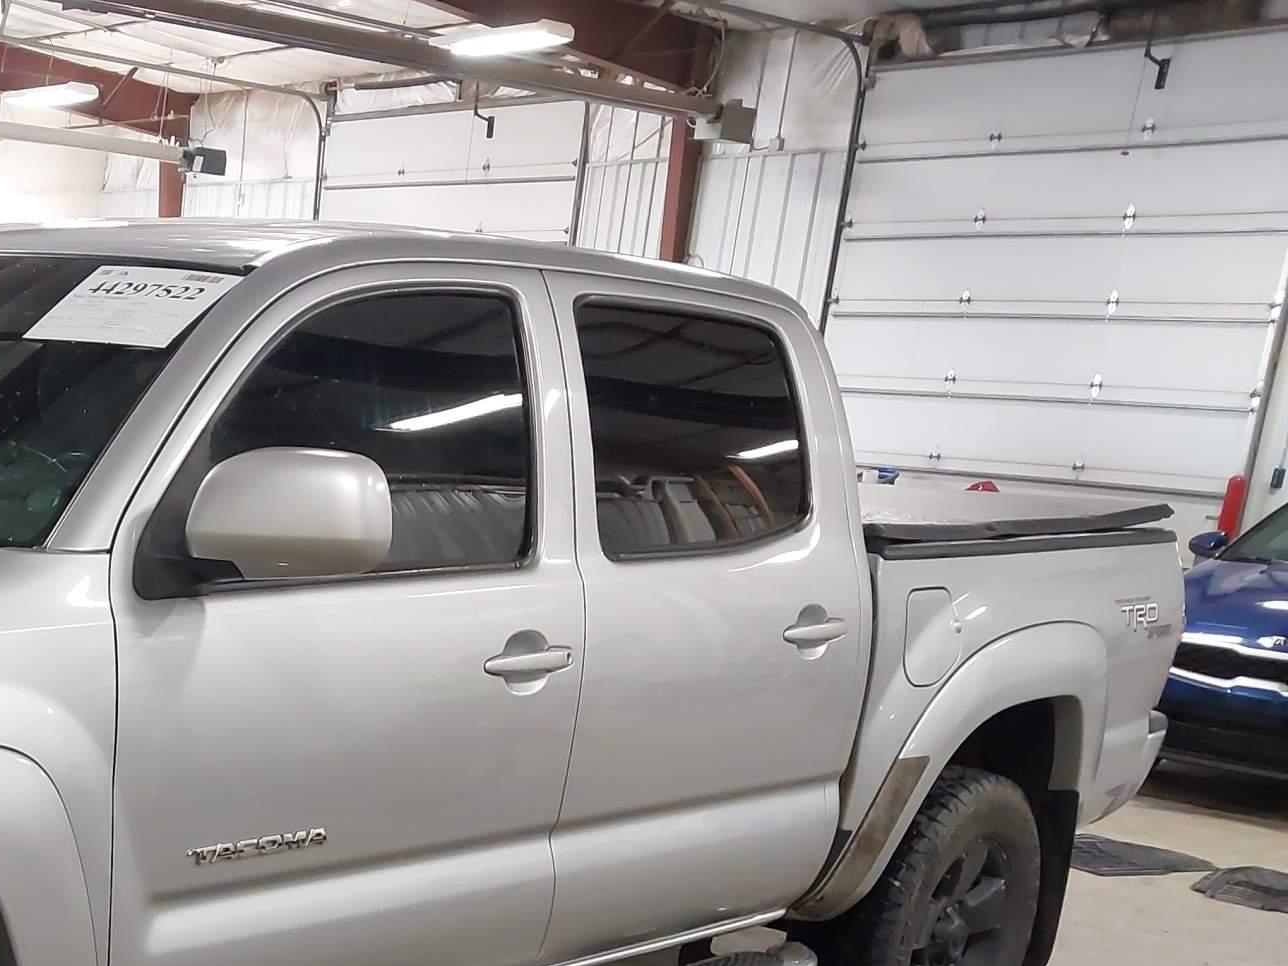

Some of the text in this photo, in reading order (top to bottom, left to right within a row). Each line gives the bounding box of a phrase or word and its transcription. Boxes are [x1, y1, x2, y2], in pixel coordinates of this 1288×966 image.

[88, 281, 206, 300] 44297522
[1120, 602, 1159, 631] TRD
[186, 827, 328, 864] TACOMA
